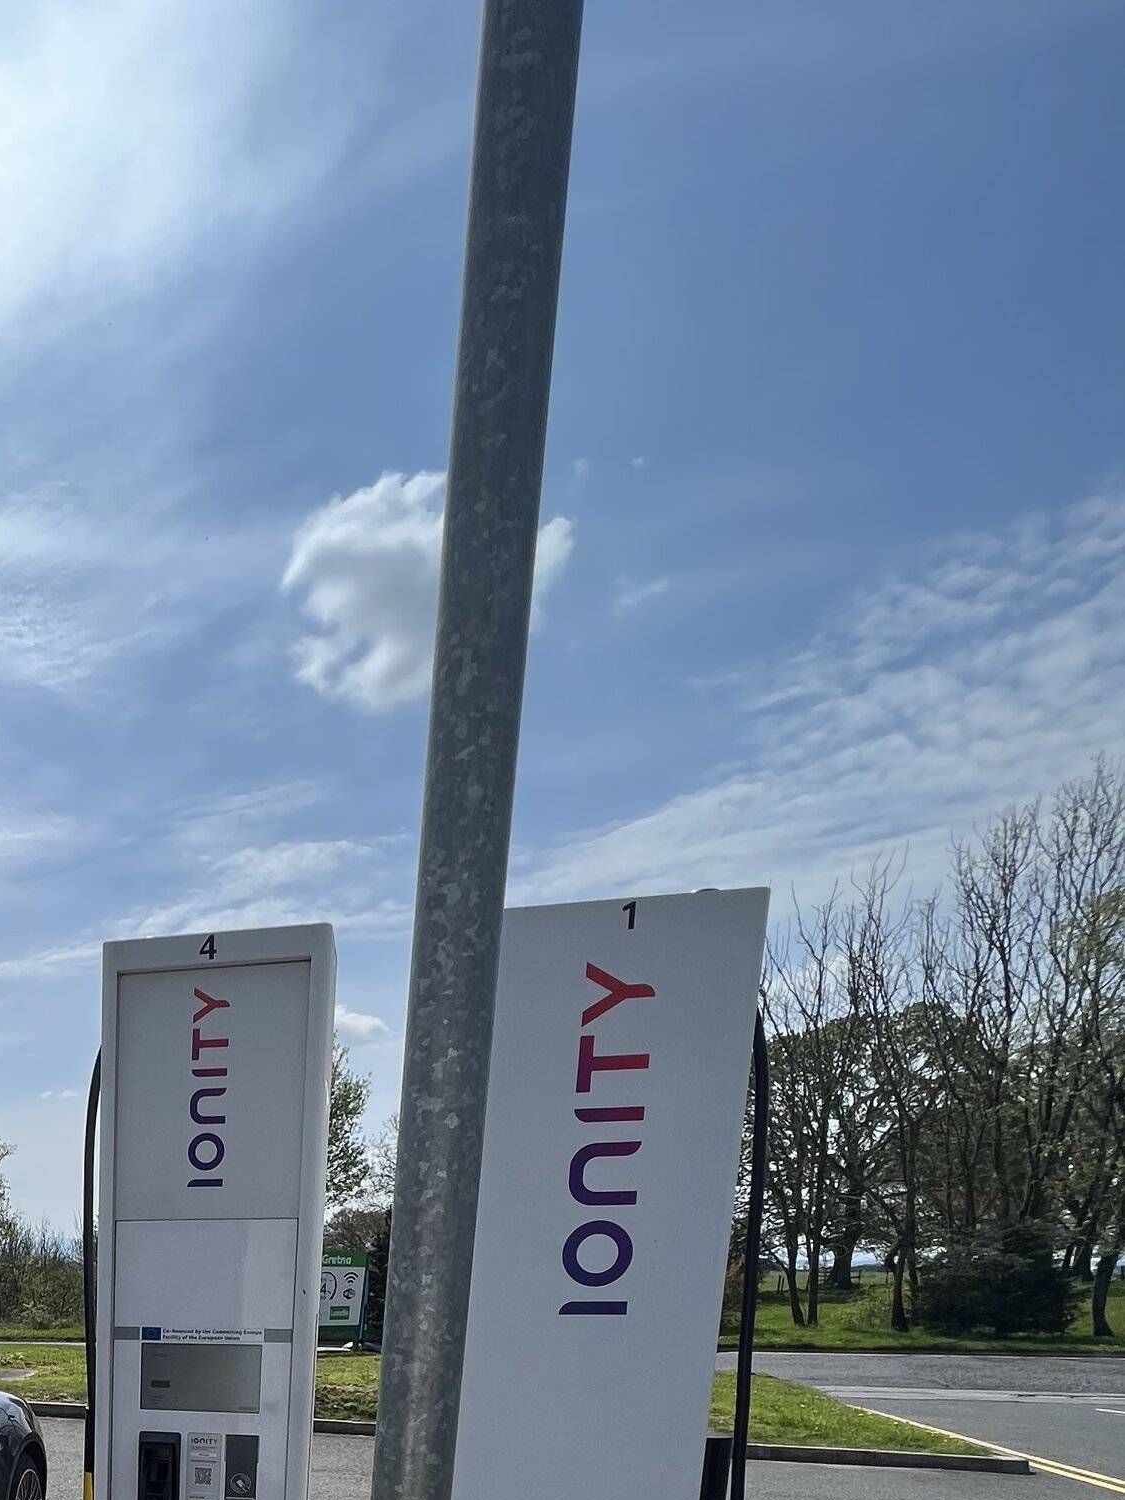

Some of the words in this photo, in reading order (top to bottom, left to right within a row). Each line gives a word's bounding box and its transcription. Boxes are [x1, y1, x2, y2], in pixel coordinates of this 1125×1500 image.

[622, 901, 637, 930] 1
[199, 934, 217, 960] 4
[187, 987, 231, 1188] IONITY
[558, 961, 656, 1316] IONITY
[322, 1254, 352, 1265] Gretna
[190, 1437, 218, 1445] IONITY
